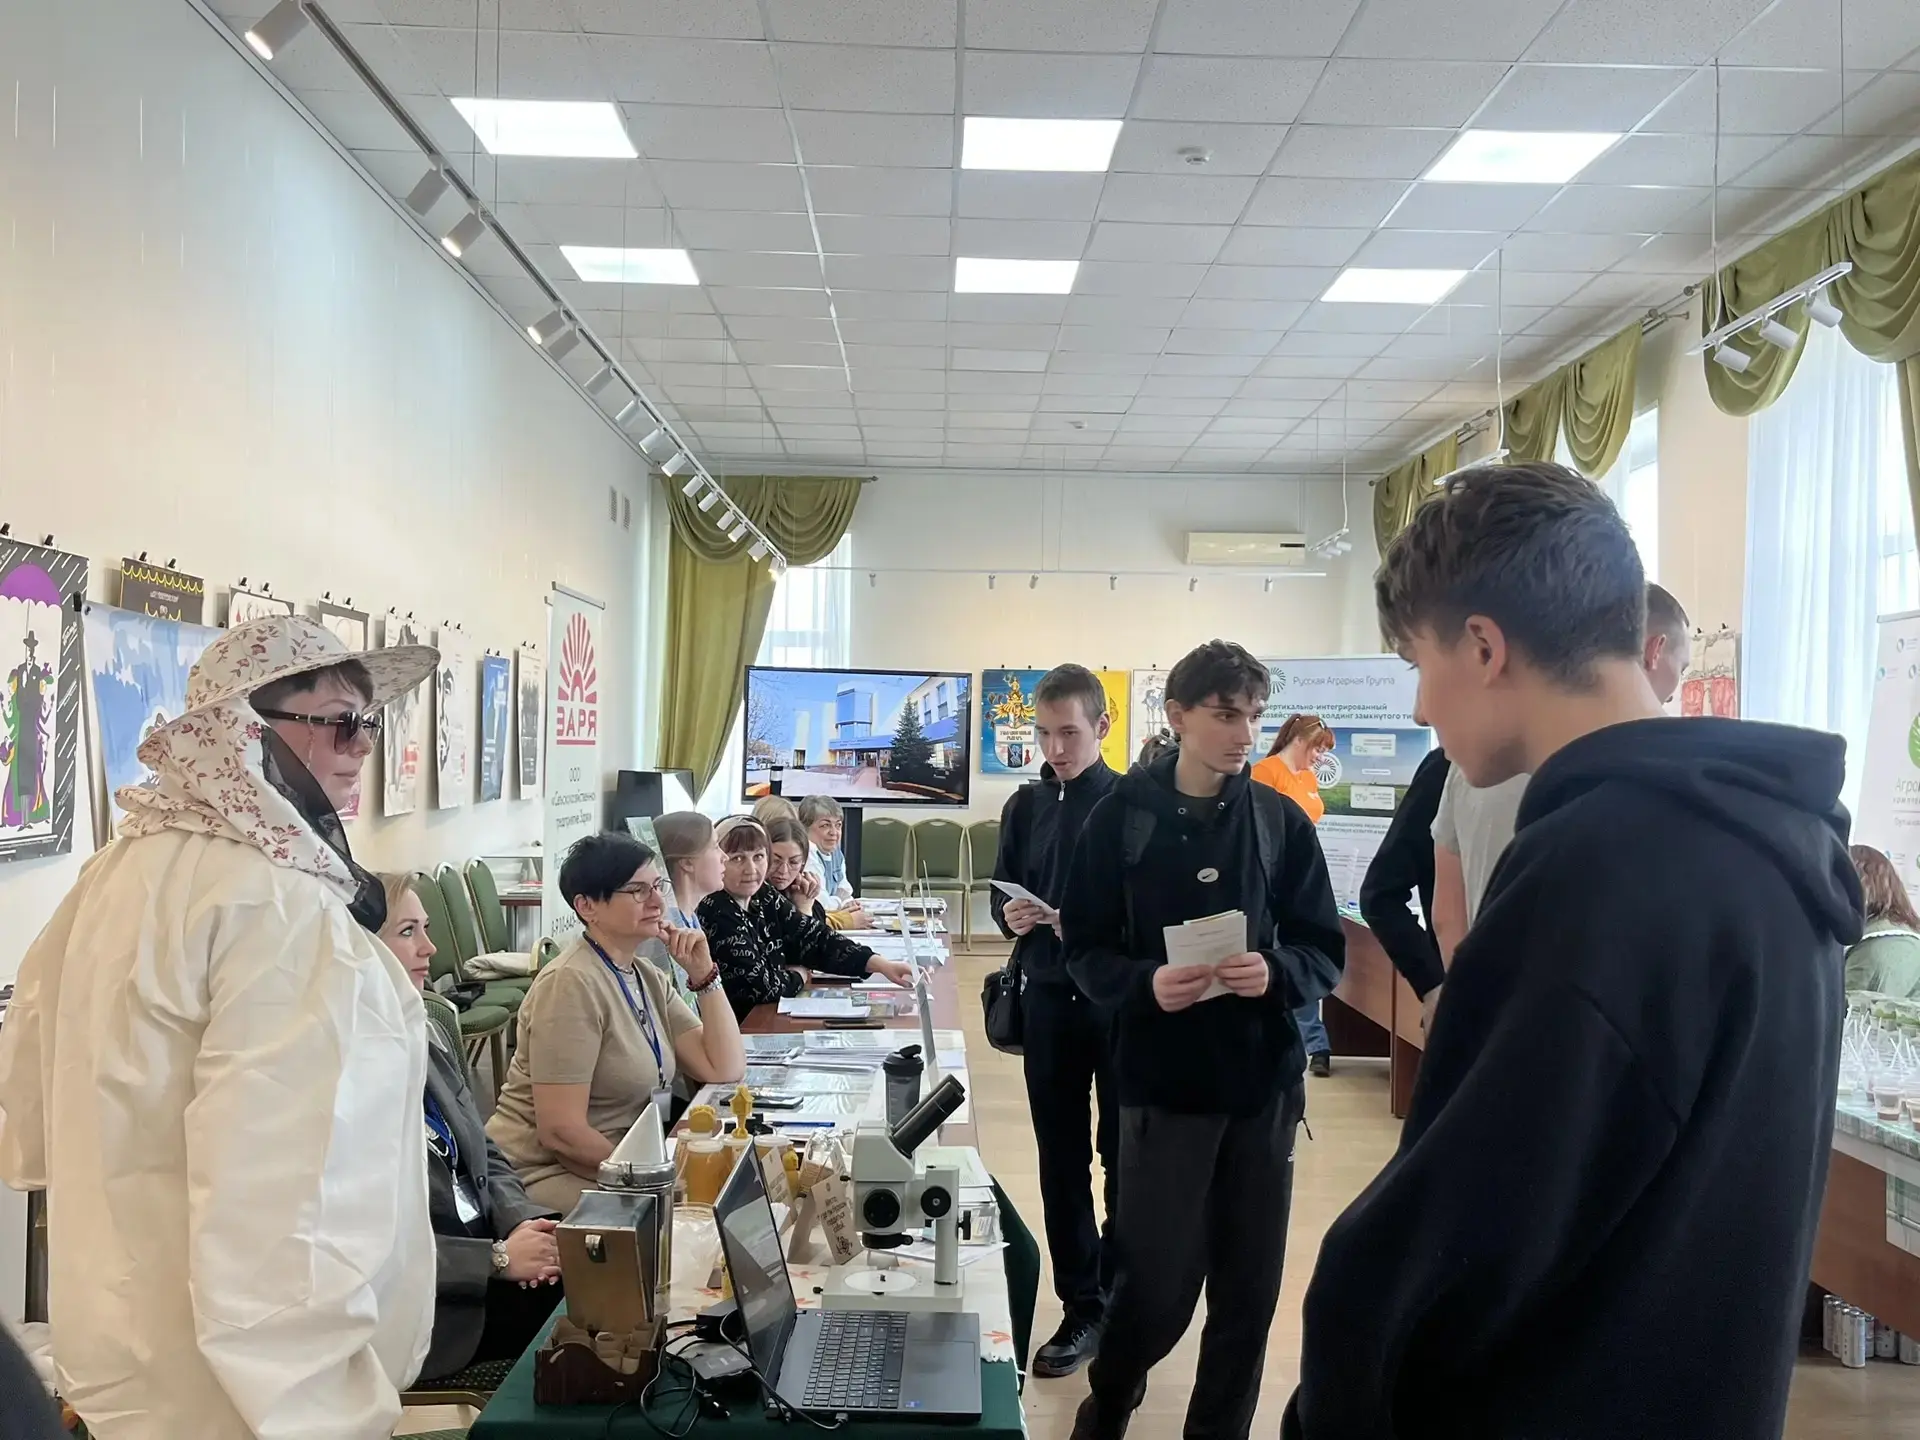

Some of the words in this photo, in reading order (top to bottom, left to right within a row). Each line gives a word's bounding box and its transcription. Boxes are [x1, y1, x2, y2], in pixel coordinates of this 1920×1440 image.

[1293, 676, 1325, 687] Русская
[1327, 676, 1364, 687] Аграрная
[1366, 675, 1395, 687] Группа
[557, 706, 597, 737] ЗАРЯ
